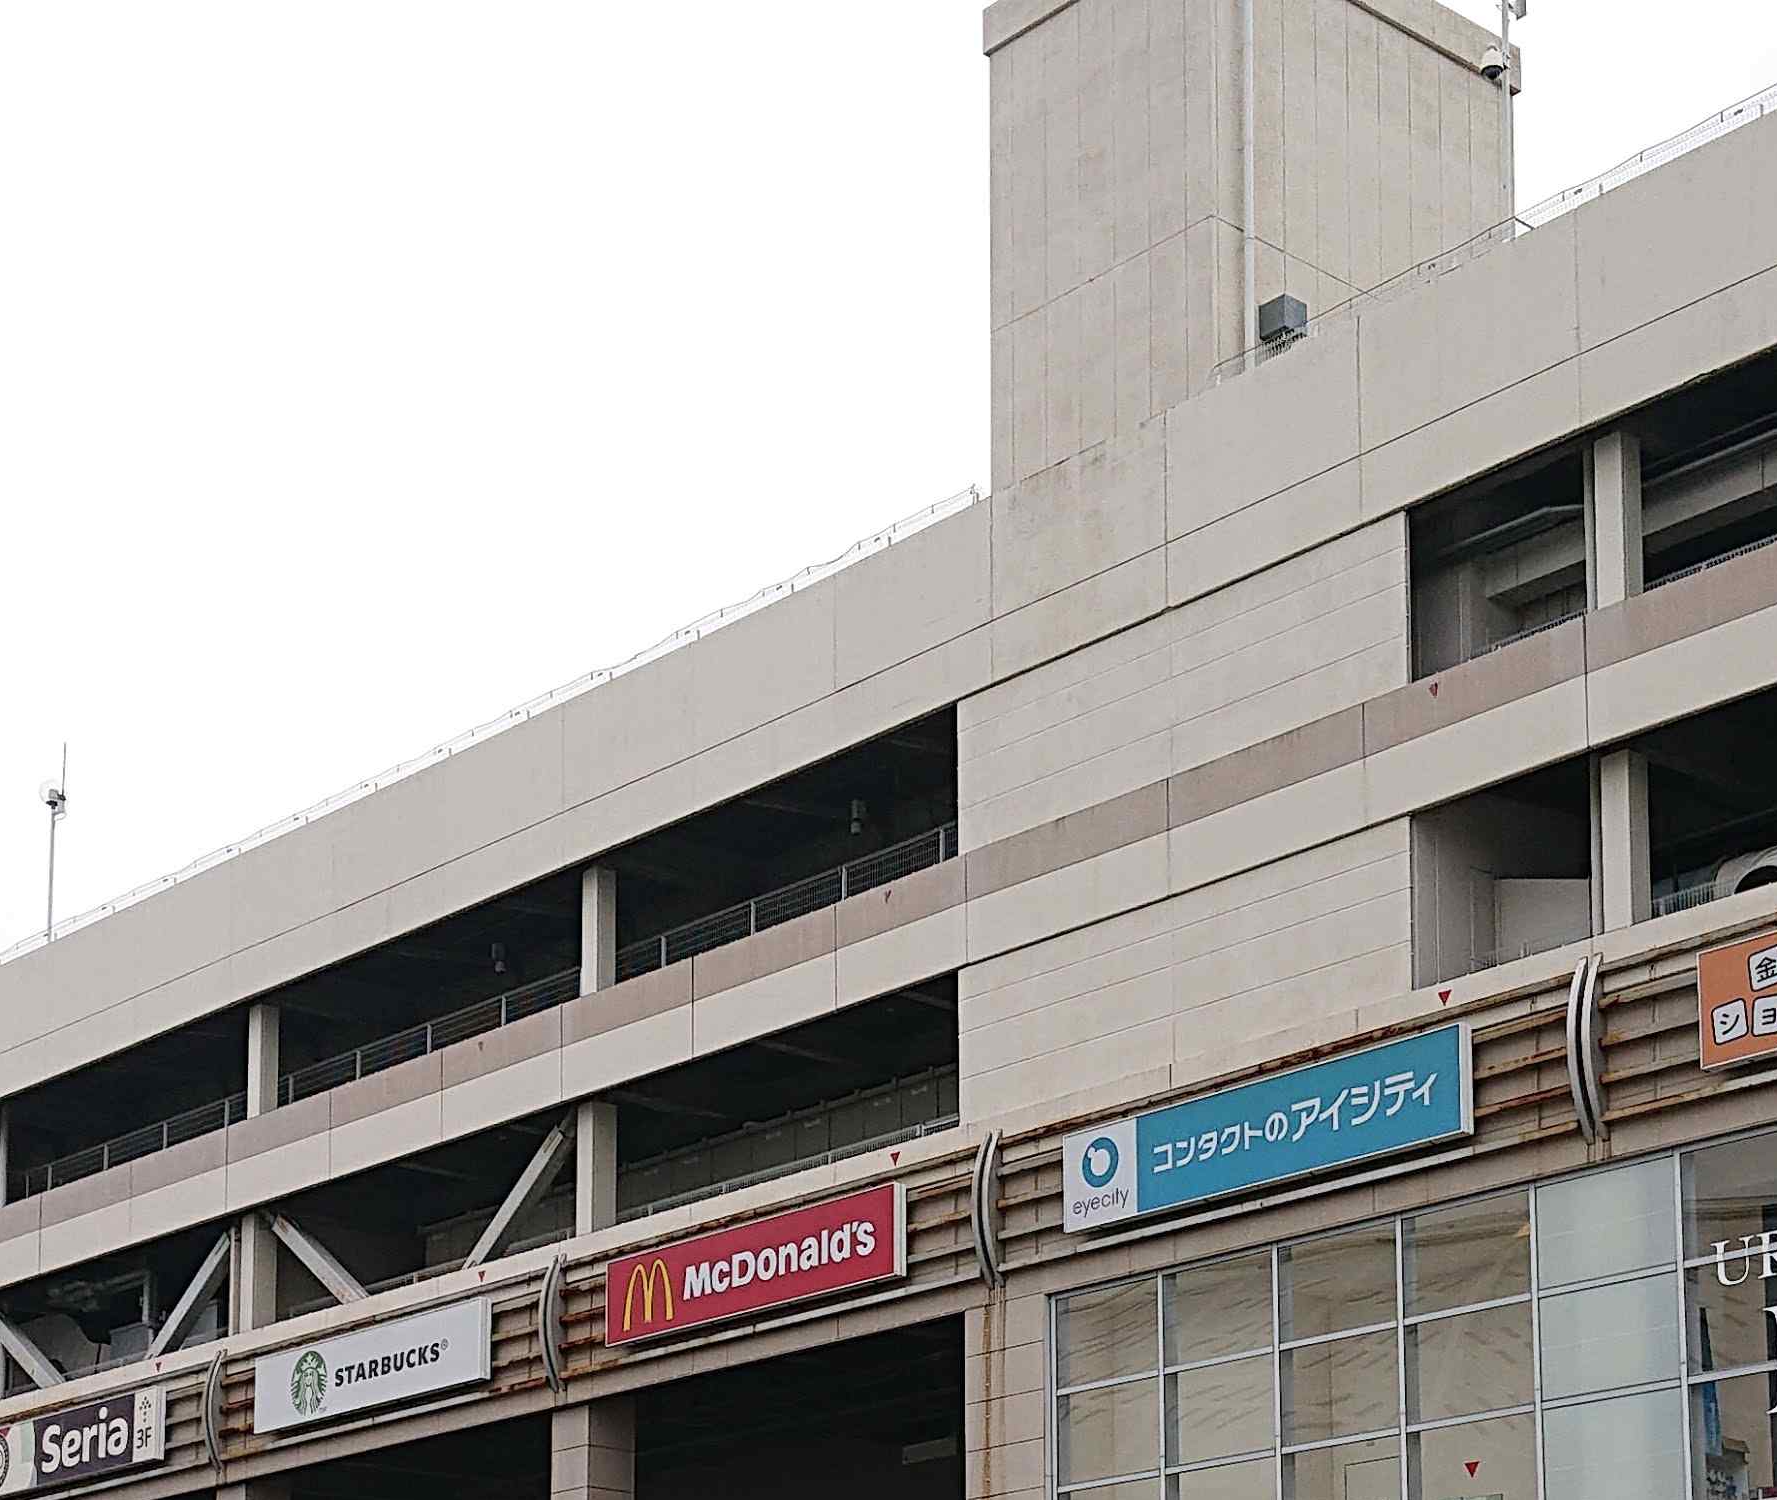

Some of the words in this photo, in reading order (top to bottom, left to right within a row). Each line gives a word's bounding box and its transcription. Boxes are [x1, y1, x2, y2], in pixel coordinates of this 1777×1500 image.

[1152, 1071, 1438, 1175] コンタクトのアイシティ
[1072, 1187, 1130, 1217] eyecity
[683, 1221, 876, 1301] McDonald's
[41, 1406, 129, 1474] Seria
[136, 1427, 152, 1449] 3F
